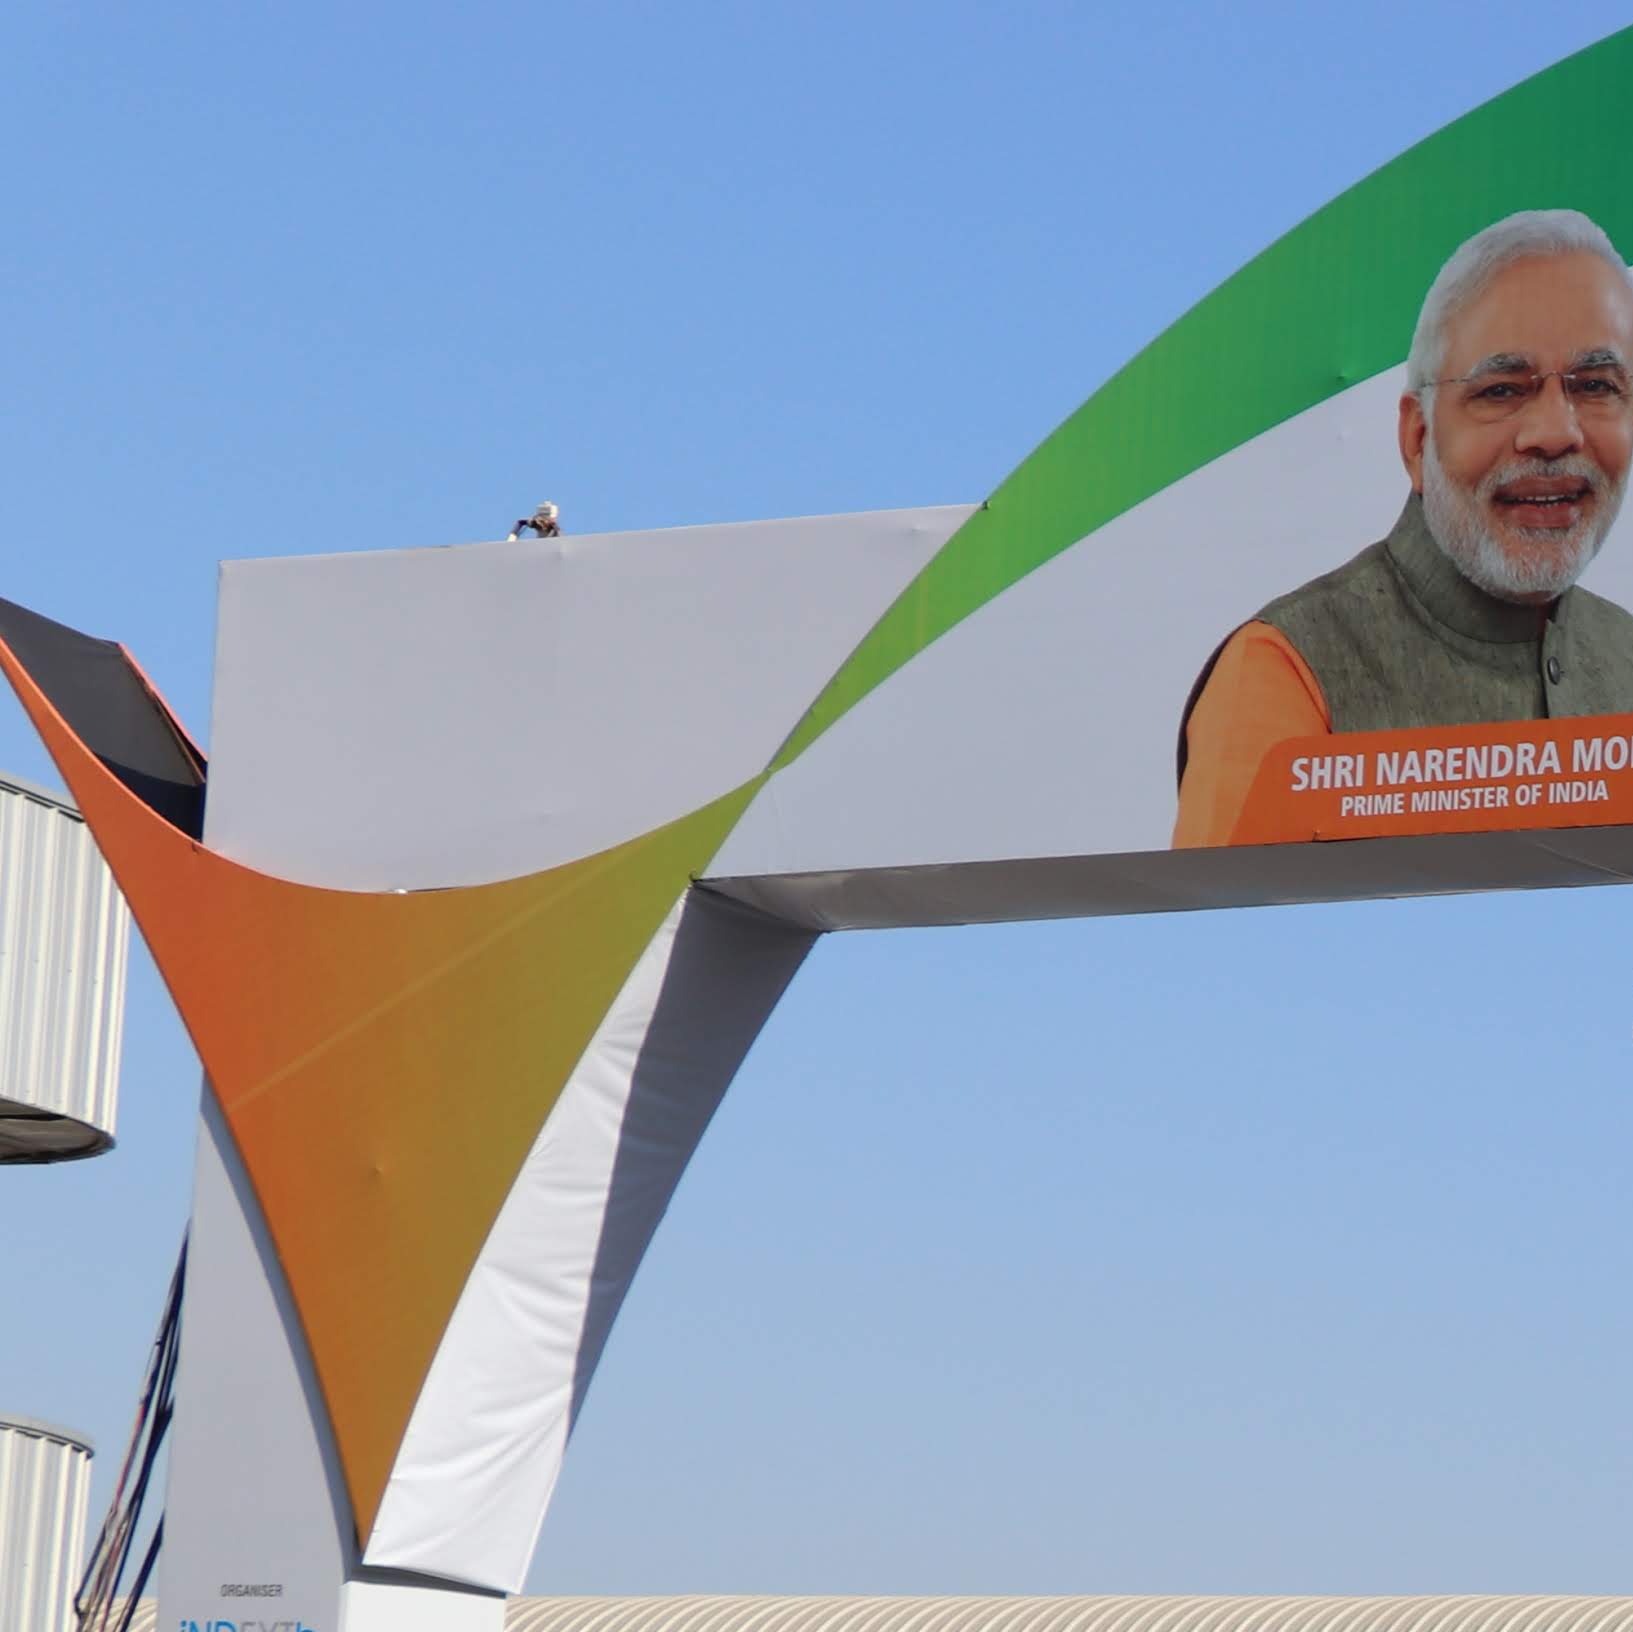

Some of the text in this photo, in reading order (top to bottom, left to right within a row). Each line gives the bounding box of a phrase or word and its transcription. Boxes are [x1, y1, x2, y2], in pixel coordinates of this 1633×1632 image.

[1291, 752, 1363, 791] SHRI
[1376, 741, 1561, 787] NARENDRA
[1340, 780, 1609, 817] PRIME MINISTER OF INDIA
[220, 1584, 283, 1597] ORGANISER
